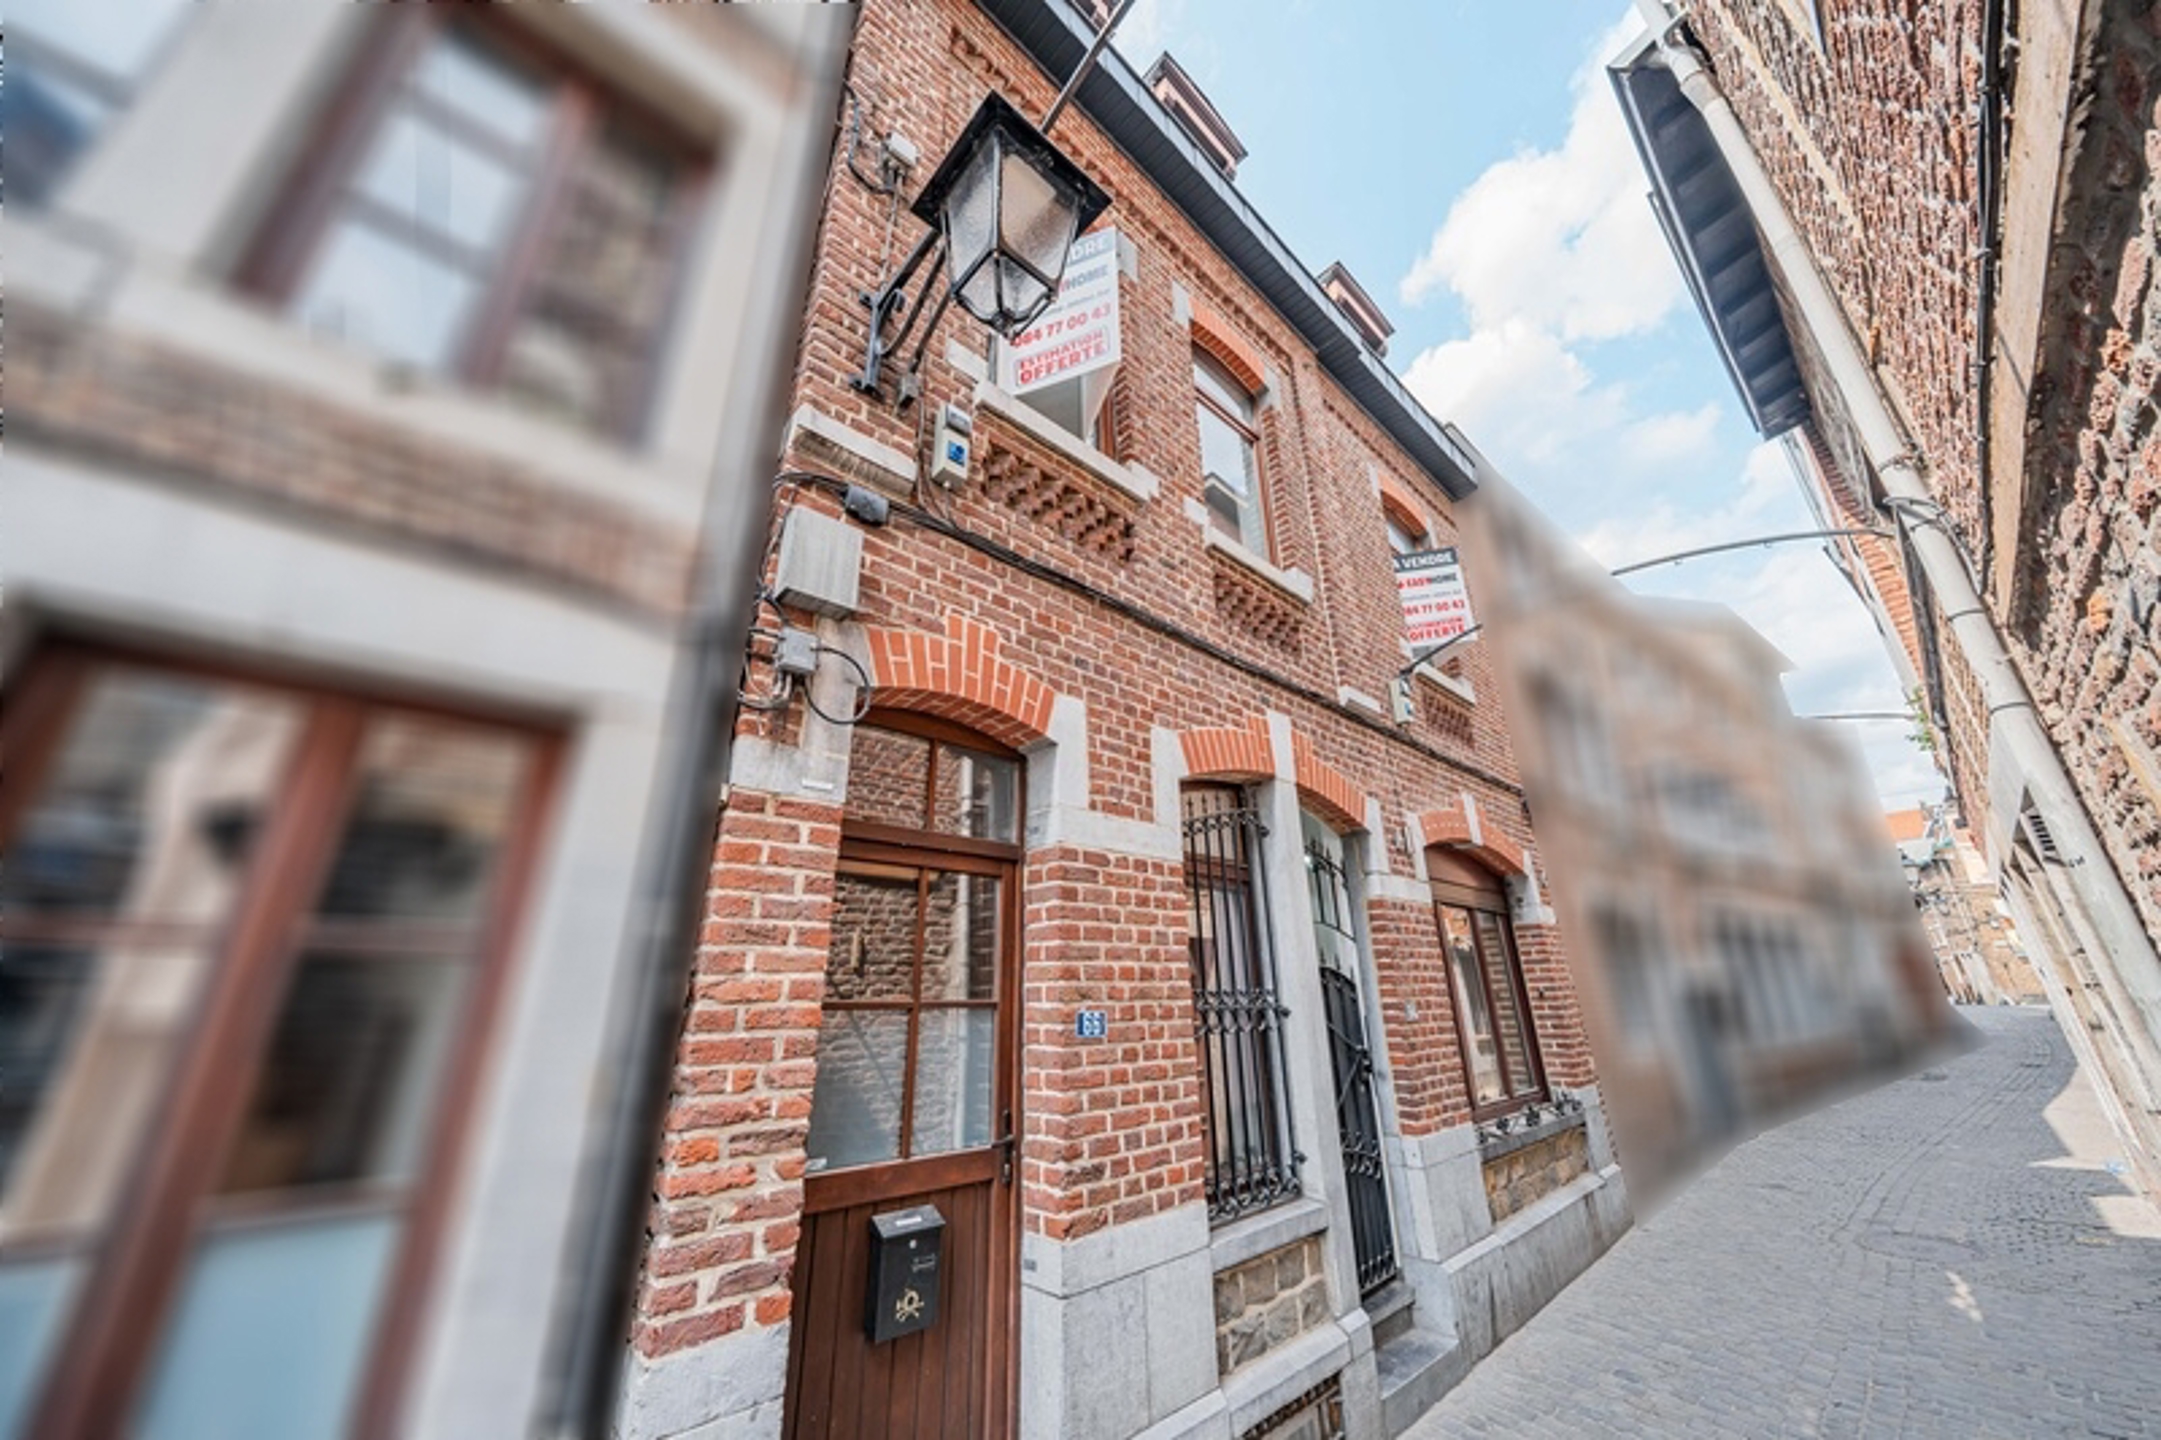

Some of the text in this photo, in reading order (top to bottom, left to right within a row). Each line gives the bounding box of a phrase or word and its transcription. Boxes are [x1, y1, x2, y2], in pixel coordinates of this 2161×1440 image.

[1068, 239, 1107, 262] DRE
[1047, 320, 1065, 337] 77
[1067, 313, 1088, 331] 00
[1020, 328, 1103, 370] ESTIMATION
[1020, 341, 1106, 385] OFFERTE
[1402, 551, 1454, 569] VENDRE
[1422, 604, 1432, 615] 77
[1409, 624, 1465, 642] OFFERTE
